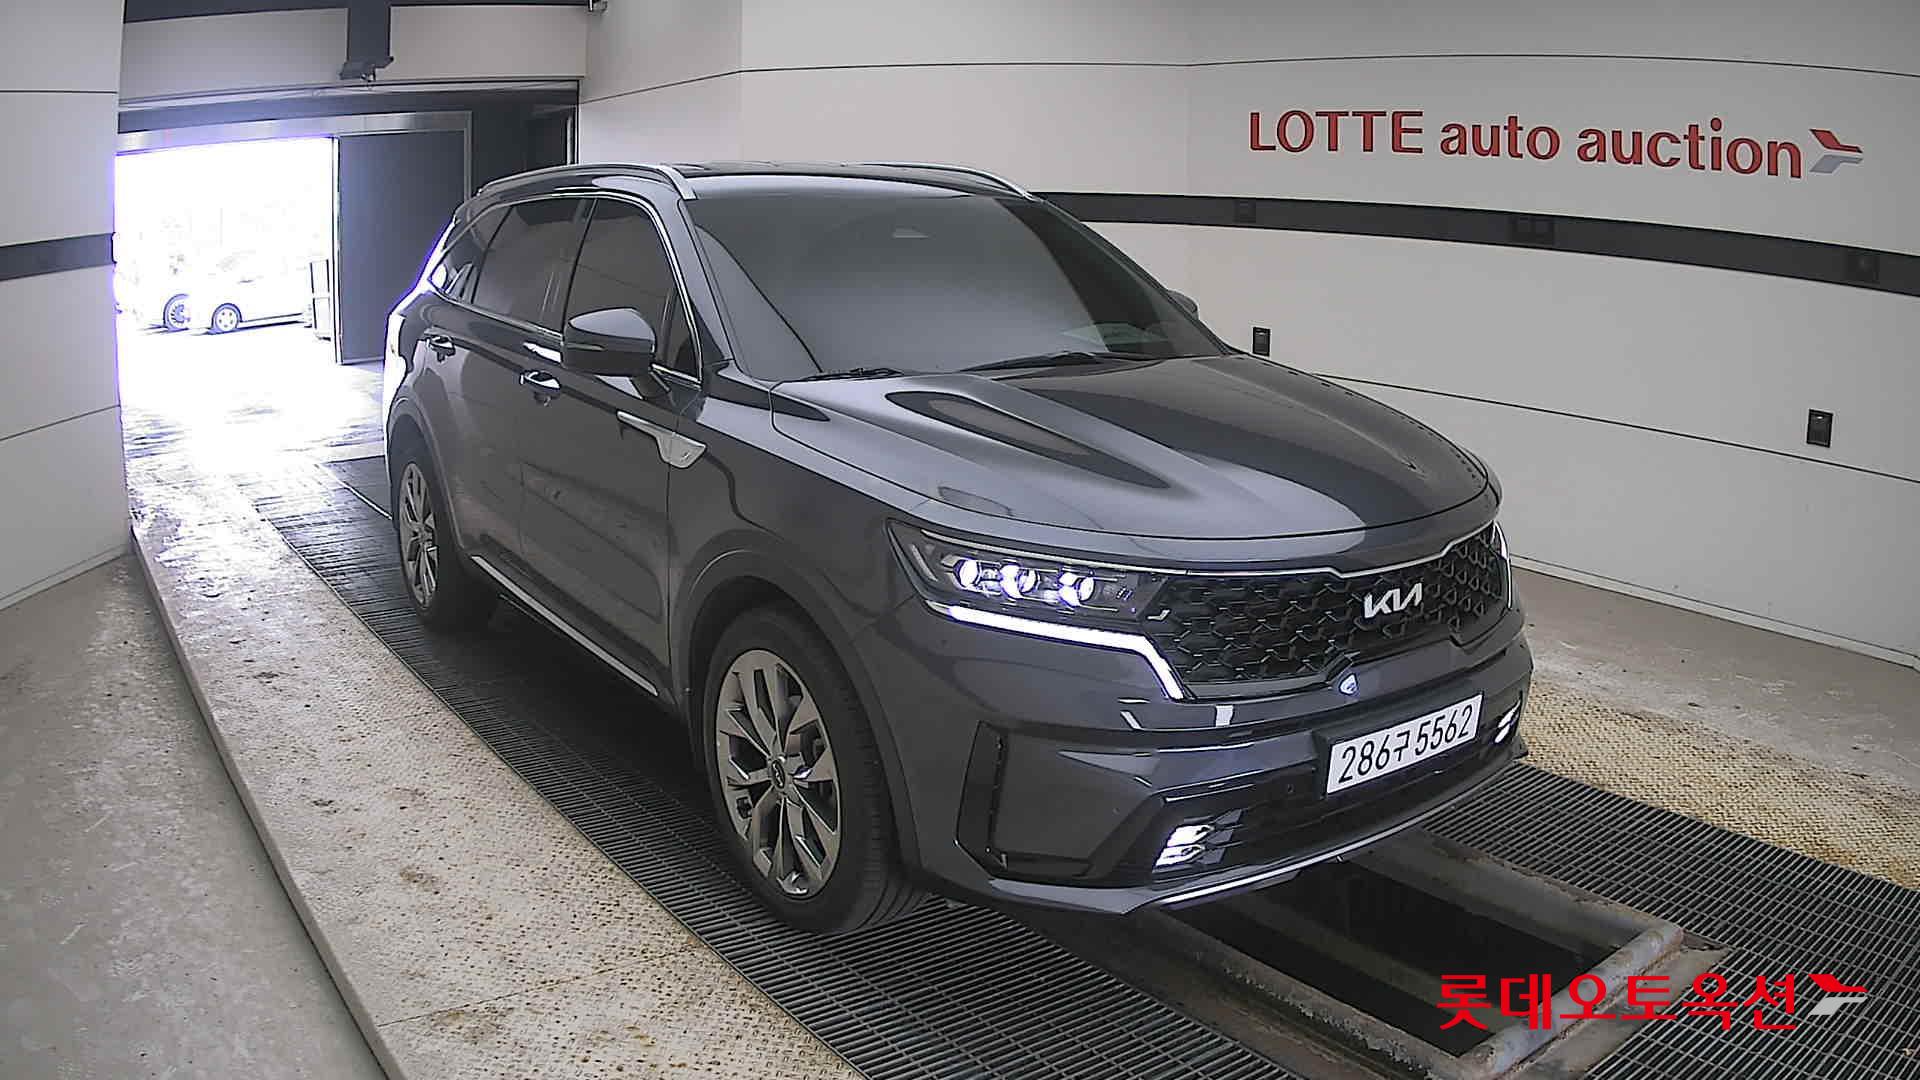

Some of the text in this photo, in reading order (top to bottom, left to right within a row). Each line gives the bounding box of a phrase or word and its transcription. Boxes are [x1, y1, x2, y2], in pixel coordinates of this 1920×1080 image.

[1250, 110, 1802, 179] LOTTE auto auction
[1363, 582, 1423, 619] KIA
